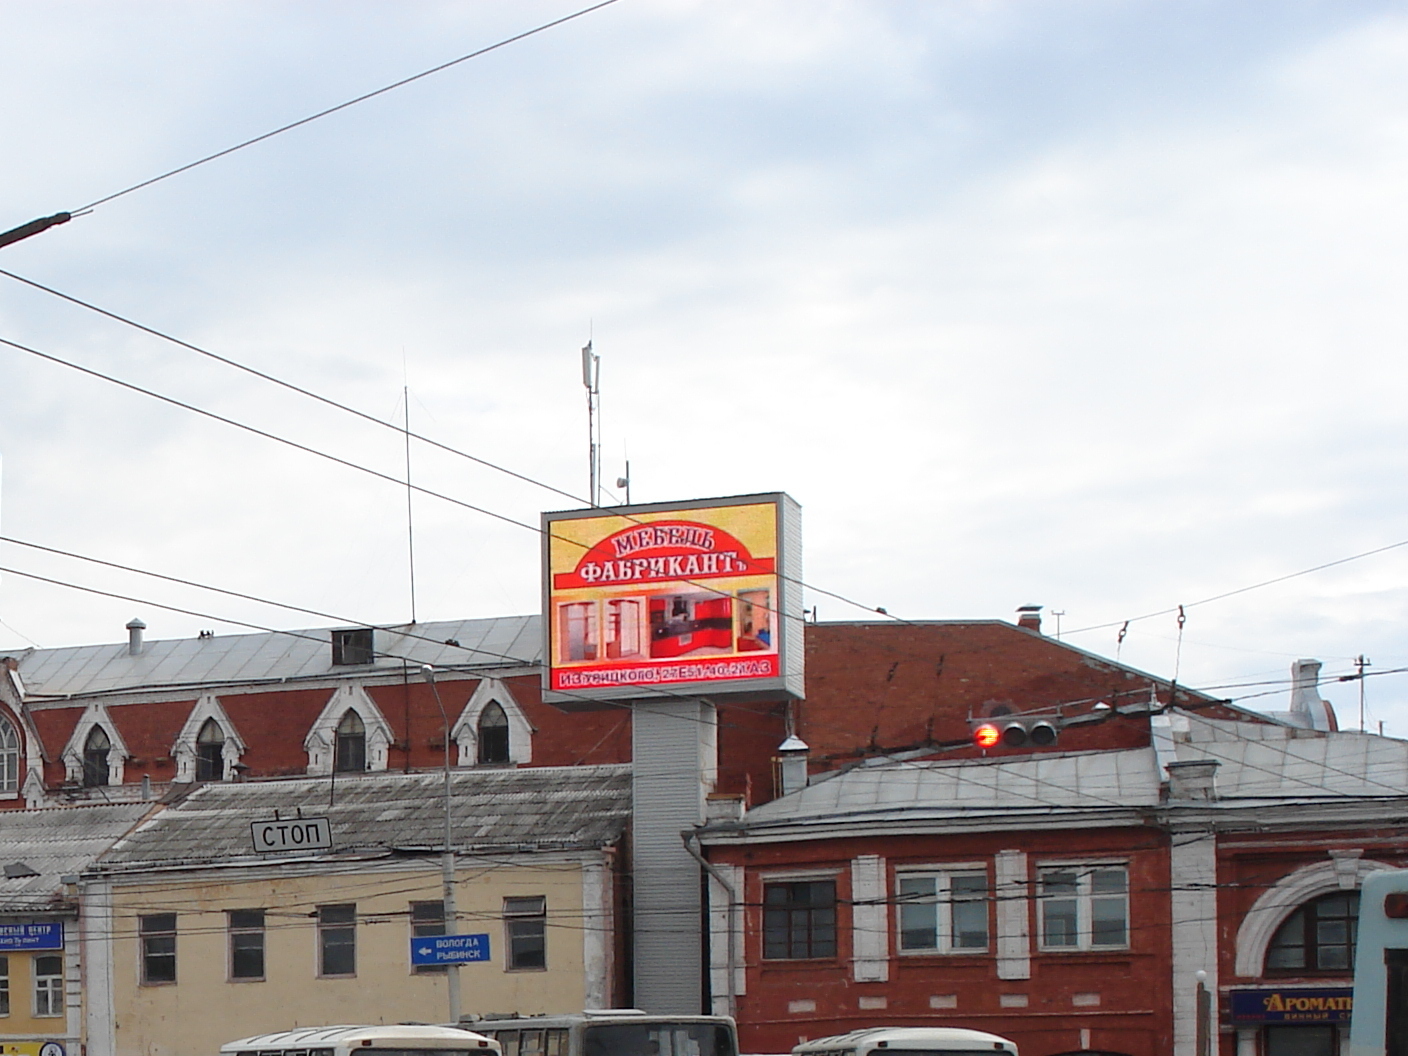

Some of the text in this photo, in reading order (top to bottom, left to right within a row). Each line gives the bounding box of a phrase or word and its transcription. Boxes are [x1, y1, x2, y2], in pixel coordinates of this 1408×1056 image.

[612, 525, 715, 558] МЕБЕЛЬ
[263, 824, 320, 846] СТОП
[28, 925, 51, 936] ЦЕНТР
[436, 938, 479, 948] ВОЛОГДА
[436, 950, 480, 960] РЫБИНСК
